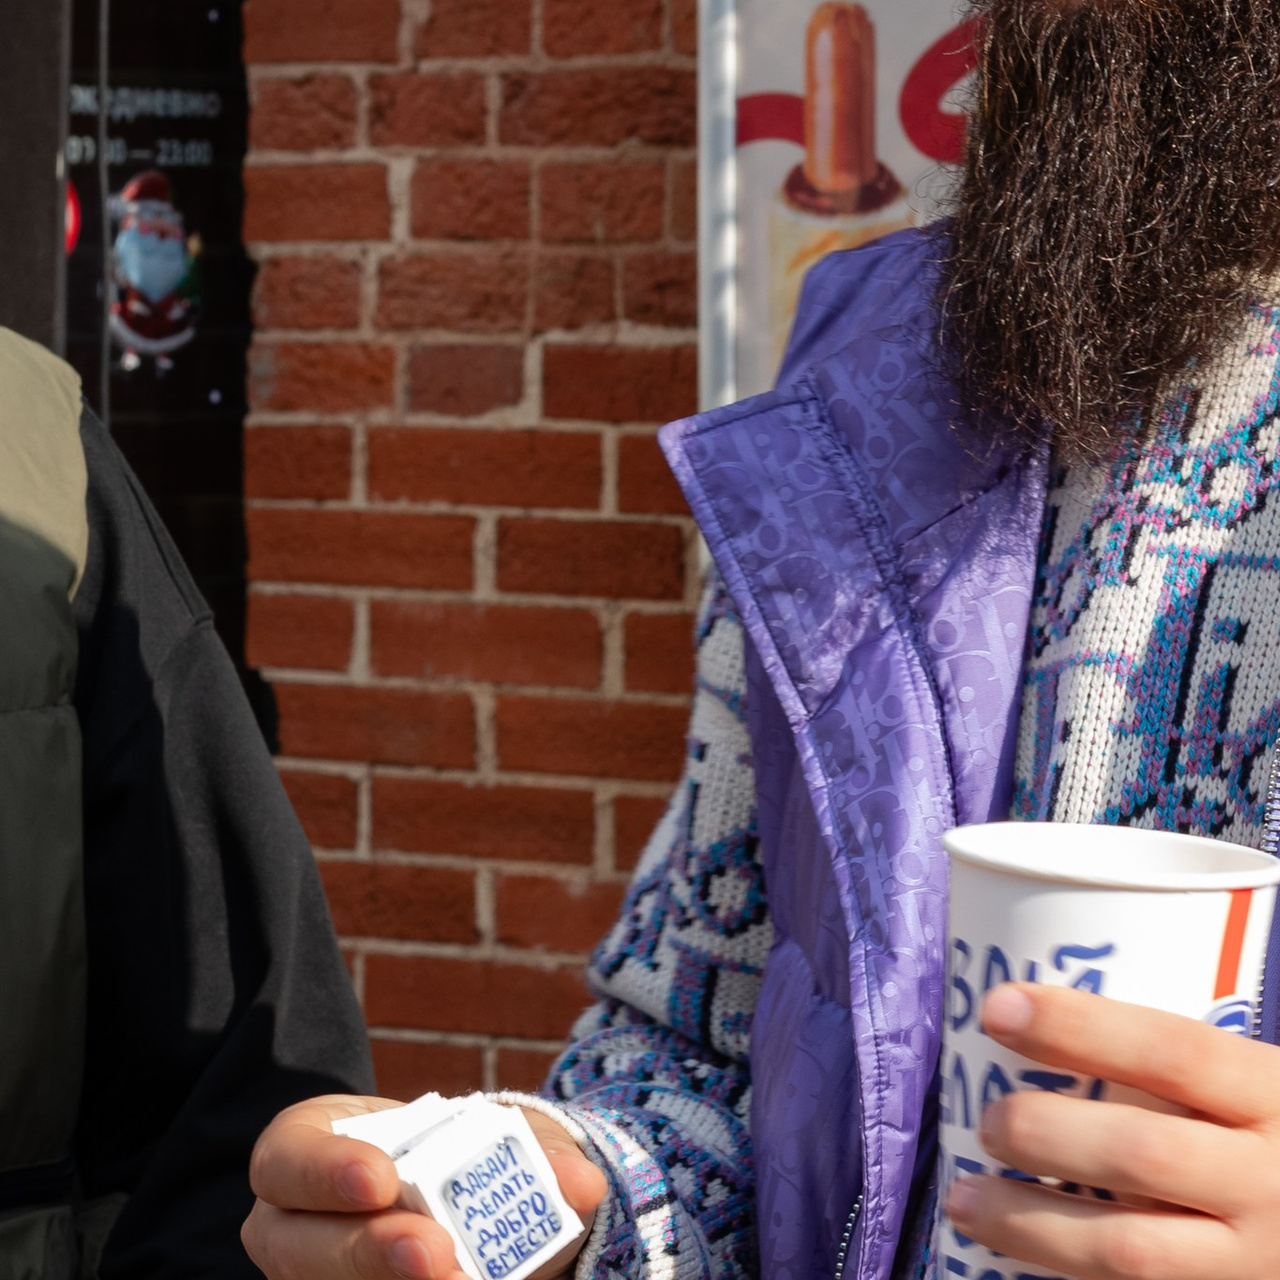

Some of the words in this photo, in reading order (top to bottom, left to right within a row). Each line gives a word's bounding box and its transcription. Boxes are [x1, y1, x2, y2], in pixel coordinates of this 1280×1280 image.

[464, 1169, 535, 1231] ДЕЛАТЬ
[477, 1191, 547, 1259] ДОБРО
[486, 1211, 562, 1280] ВМЕСТЕ
